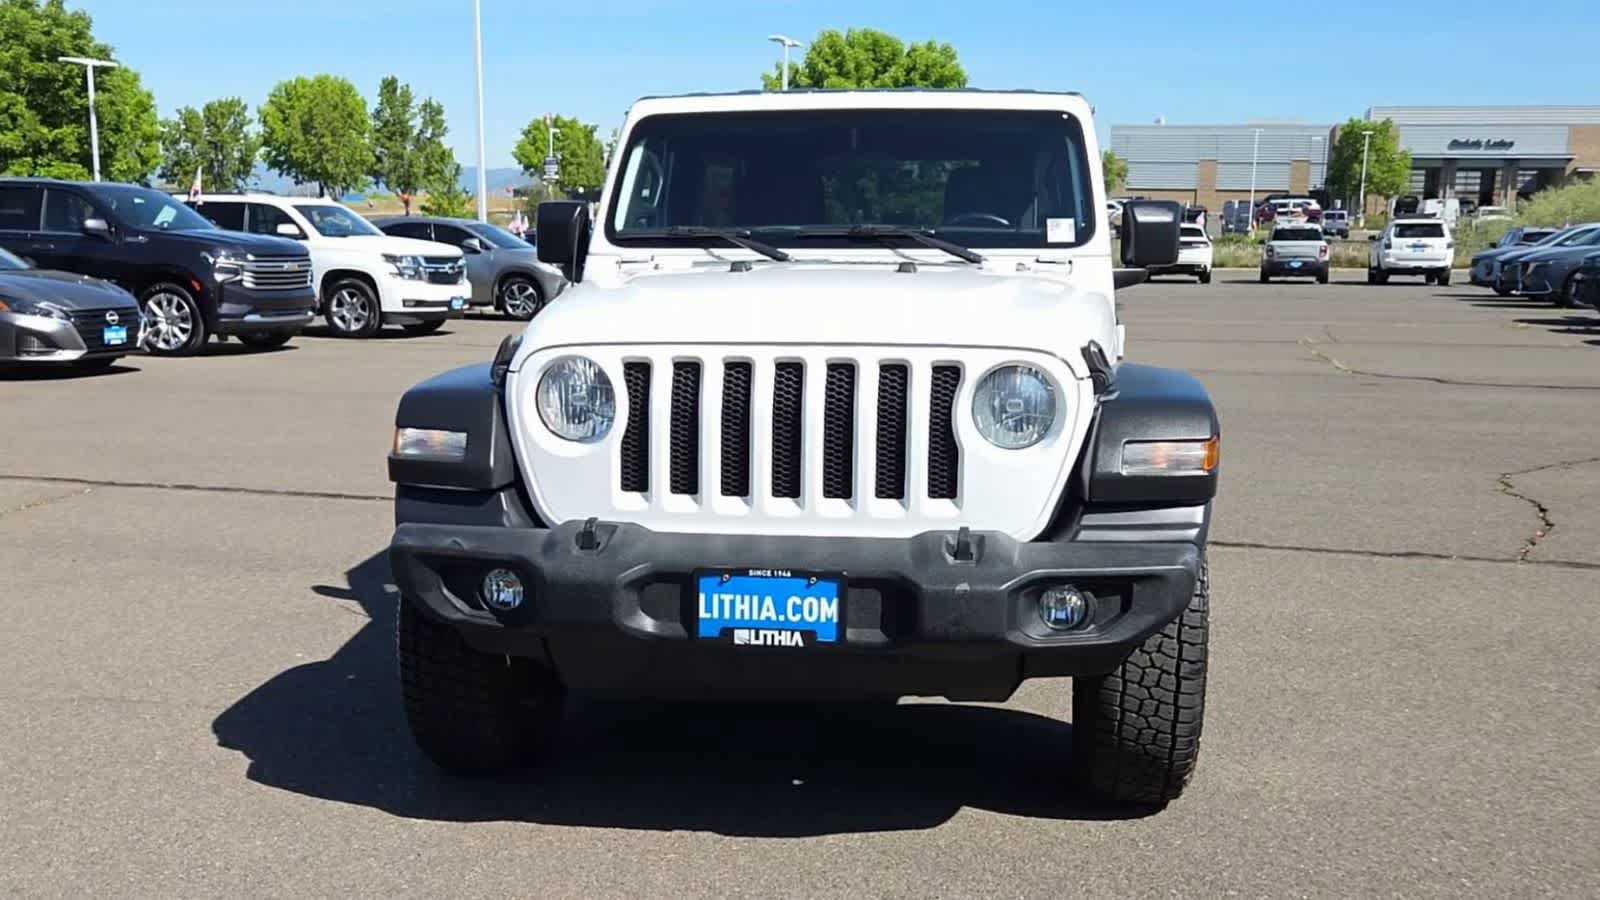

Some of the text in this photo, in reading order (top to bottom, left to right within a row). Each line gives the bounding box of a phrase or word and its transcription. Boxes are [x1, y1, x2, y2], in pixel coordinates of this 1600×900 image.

[749, 569, 771, 577] SINCE
[699, 592, 839, 623] LITHIA.COM
[750, 629, 804, 647] LITHIA
